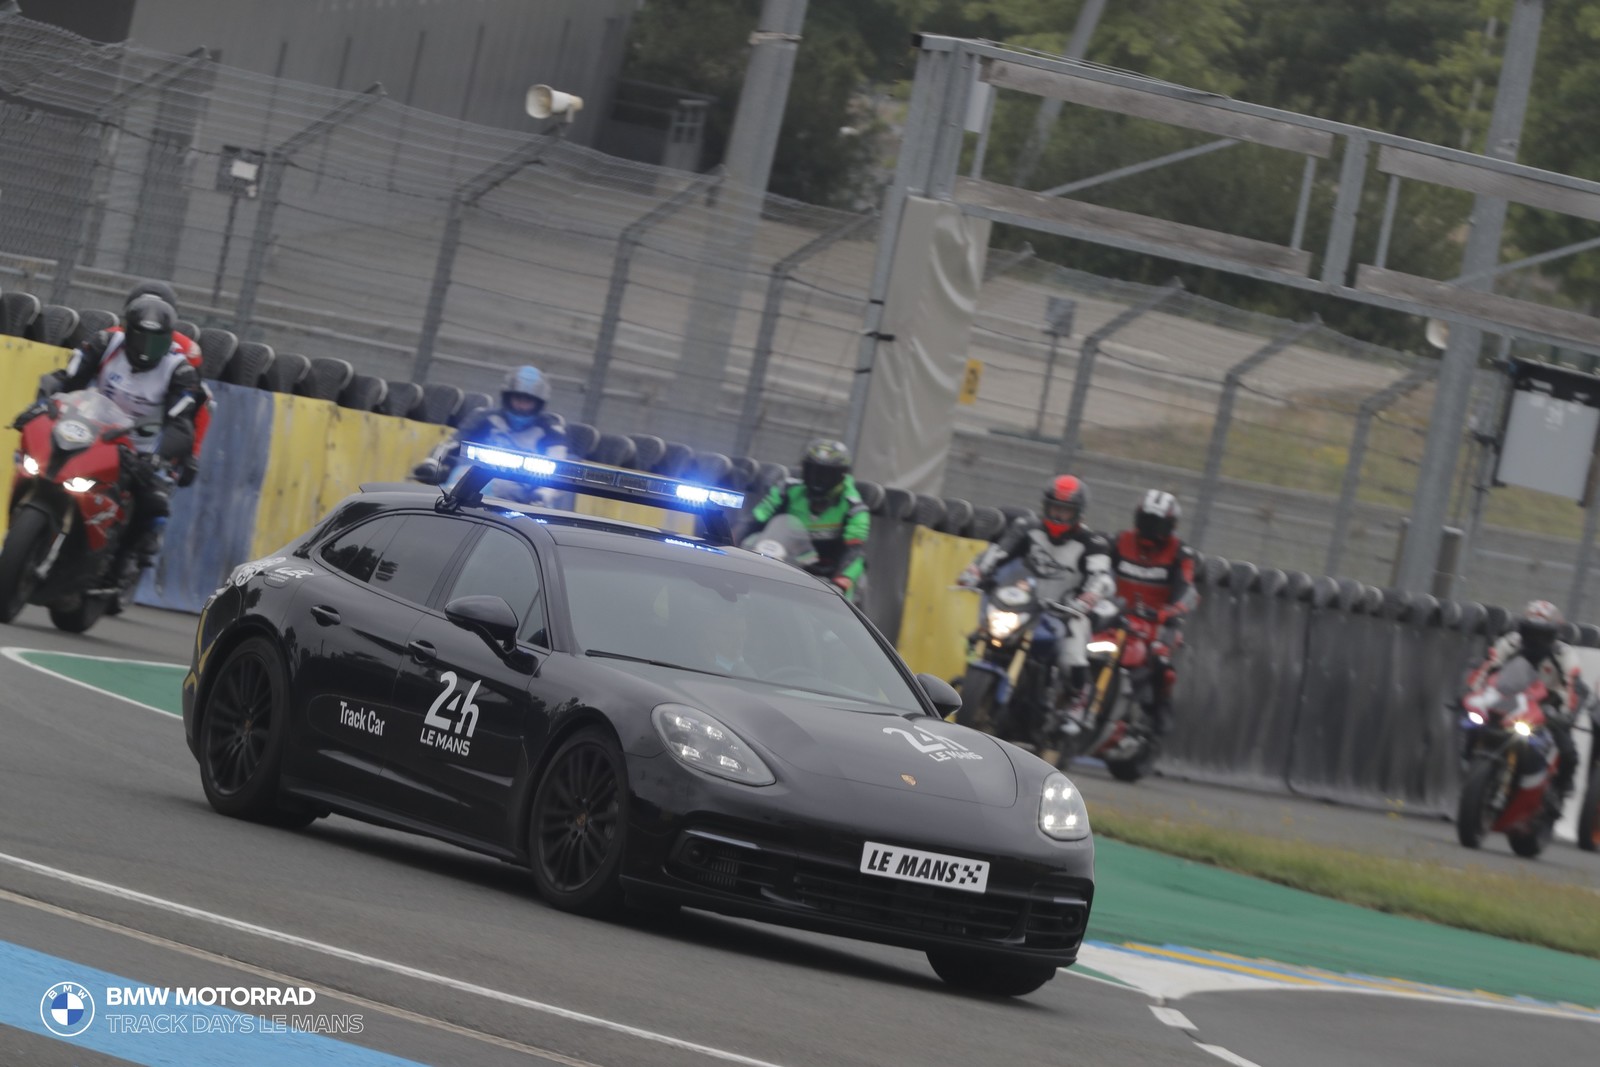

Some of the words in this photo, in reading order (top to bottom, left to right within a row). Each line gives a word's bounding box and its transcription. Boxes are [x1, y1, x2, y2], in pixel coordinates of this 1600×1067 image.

[340, 701, 366, 732] Track
[367, 710, 386, 736] Car
[423, 670, 482, 738] 24h
[419, 728, 436, 746] LE
[435, 732, 471, 757] MANS
[928, 751, 952, 762] LE
[867, 849, 893, 873] LE
[895, 854, 960, 884] MANS
